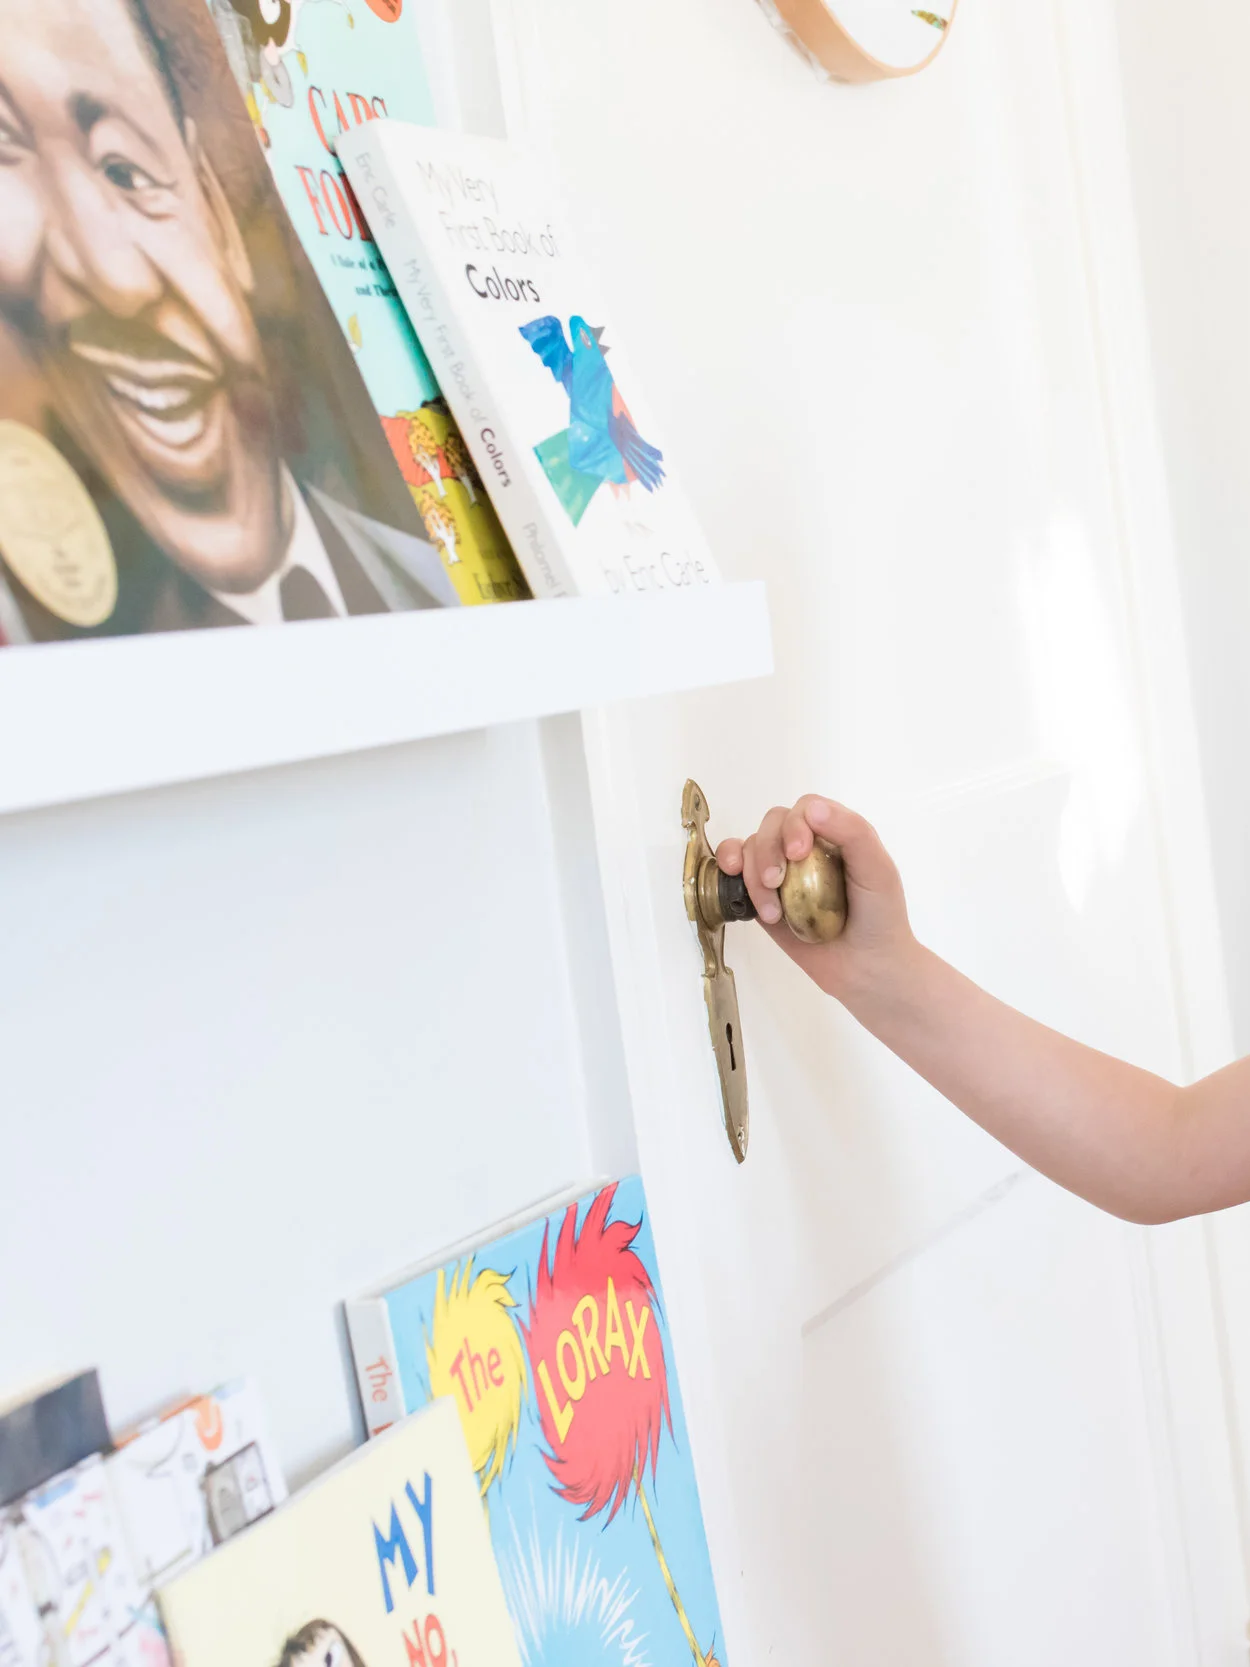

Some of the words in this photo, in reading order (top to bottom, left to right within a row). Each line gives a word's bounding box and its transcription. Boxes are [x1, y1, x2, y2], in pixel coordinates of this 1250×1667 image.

[465, 263, 541, 303] Colors
[482, 216, 542, 256] Book
[540, 223, 562, 258] of
[416, 281, 438, 320] Very
[450, 360, 475, 403] Book
[469, 406, 489, 426] of
[480, 427, 513, 489] Colors
[365, 1354, 394, 1403] The
[450, 1335, 505, 1414] The
[537, 1275, 653, 1444] LORAX
[370, 1467, 436, 1615] MY
